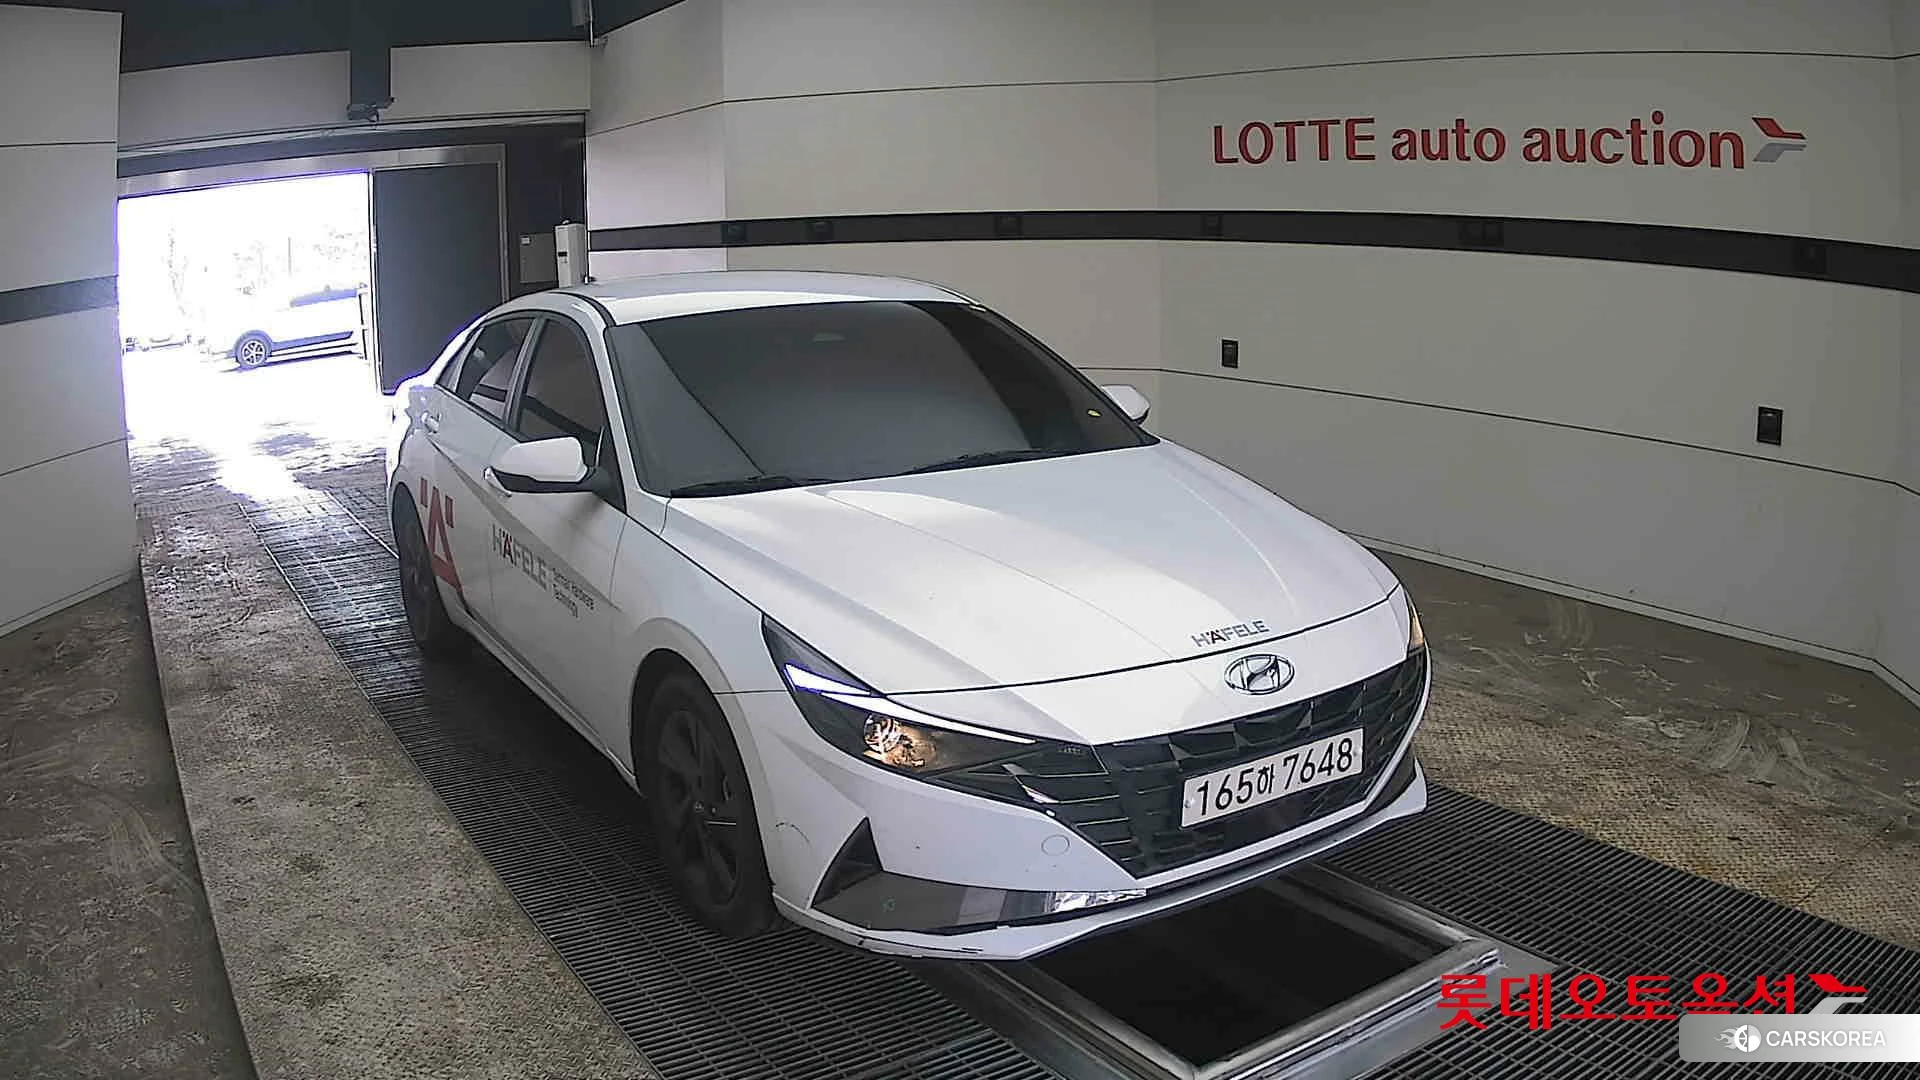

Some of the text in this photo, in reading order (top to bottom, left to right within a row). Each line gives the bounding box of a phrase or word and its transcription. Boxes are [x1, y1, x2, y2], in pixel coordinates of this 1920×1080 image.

[1213, 110, 1746, 169] LOTTE auto auction
[1191, 620, 1270, 648] HÄFELE
[1196, 737, 1354, 817] 165하 7648
